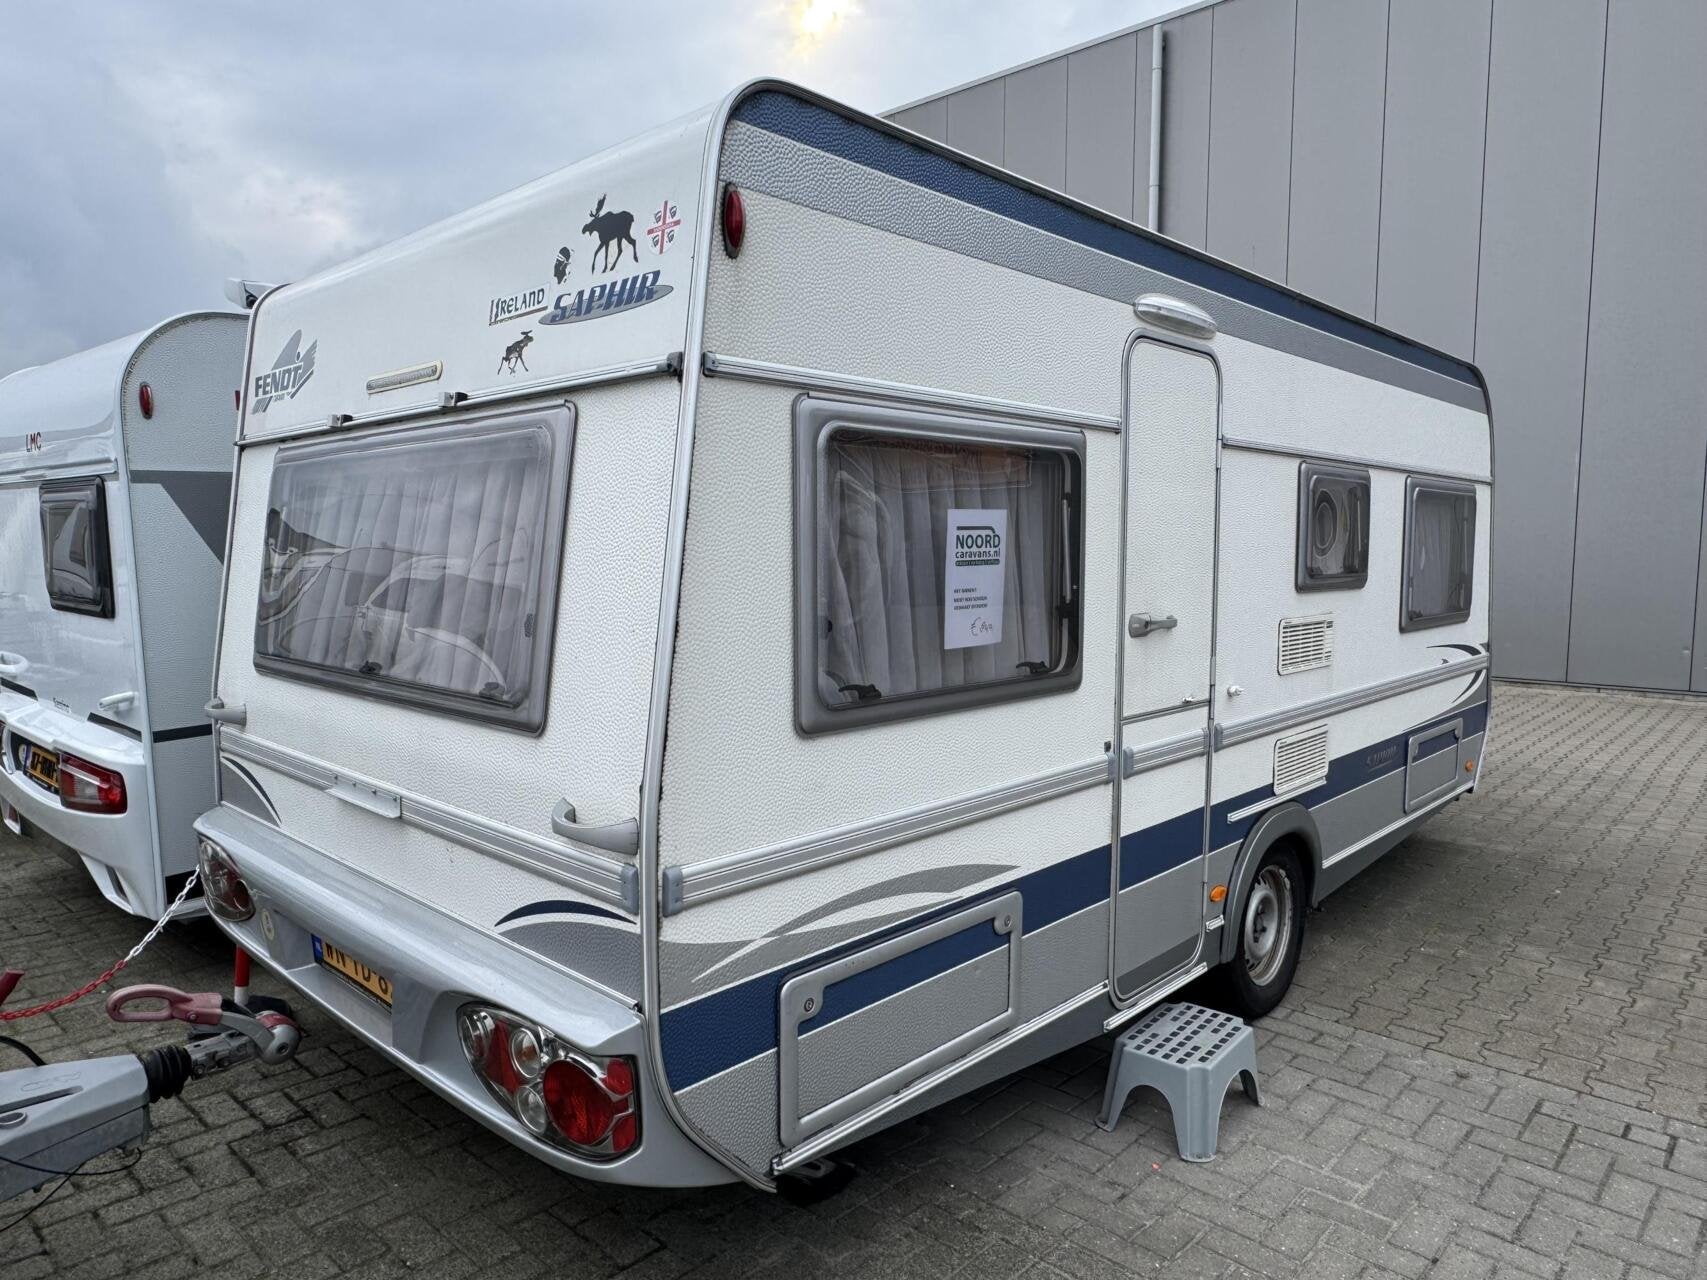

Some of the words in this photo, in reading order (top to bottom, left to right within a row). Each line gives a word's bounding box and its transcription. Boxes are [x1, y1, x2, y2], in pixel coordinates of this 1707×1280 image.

[494, 288, 545, 320] IRELAND
[551, 270, 661, 323] SAPHIR
[255, 365, 303, 398] FENDT
[25, 431, 42, 453] LMC
[955, 534, 1001, 549] NOORD
[955, 548, 1001, 559] caravans.nl
